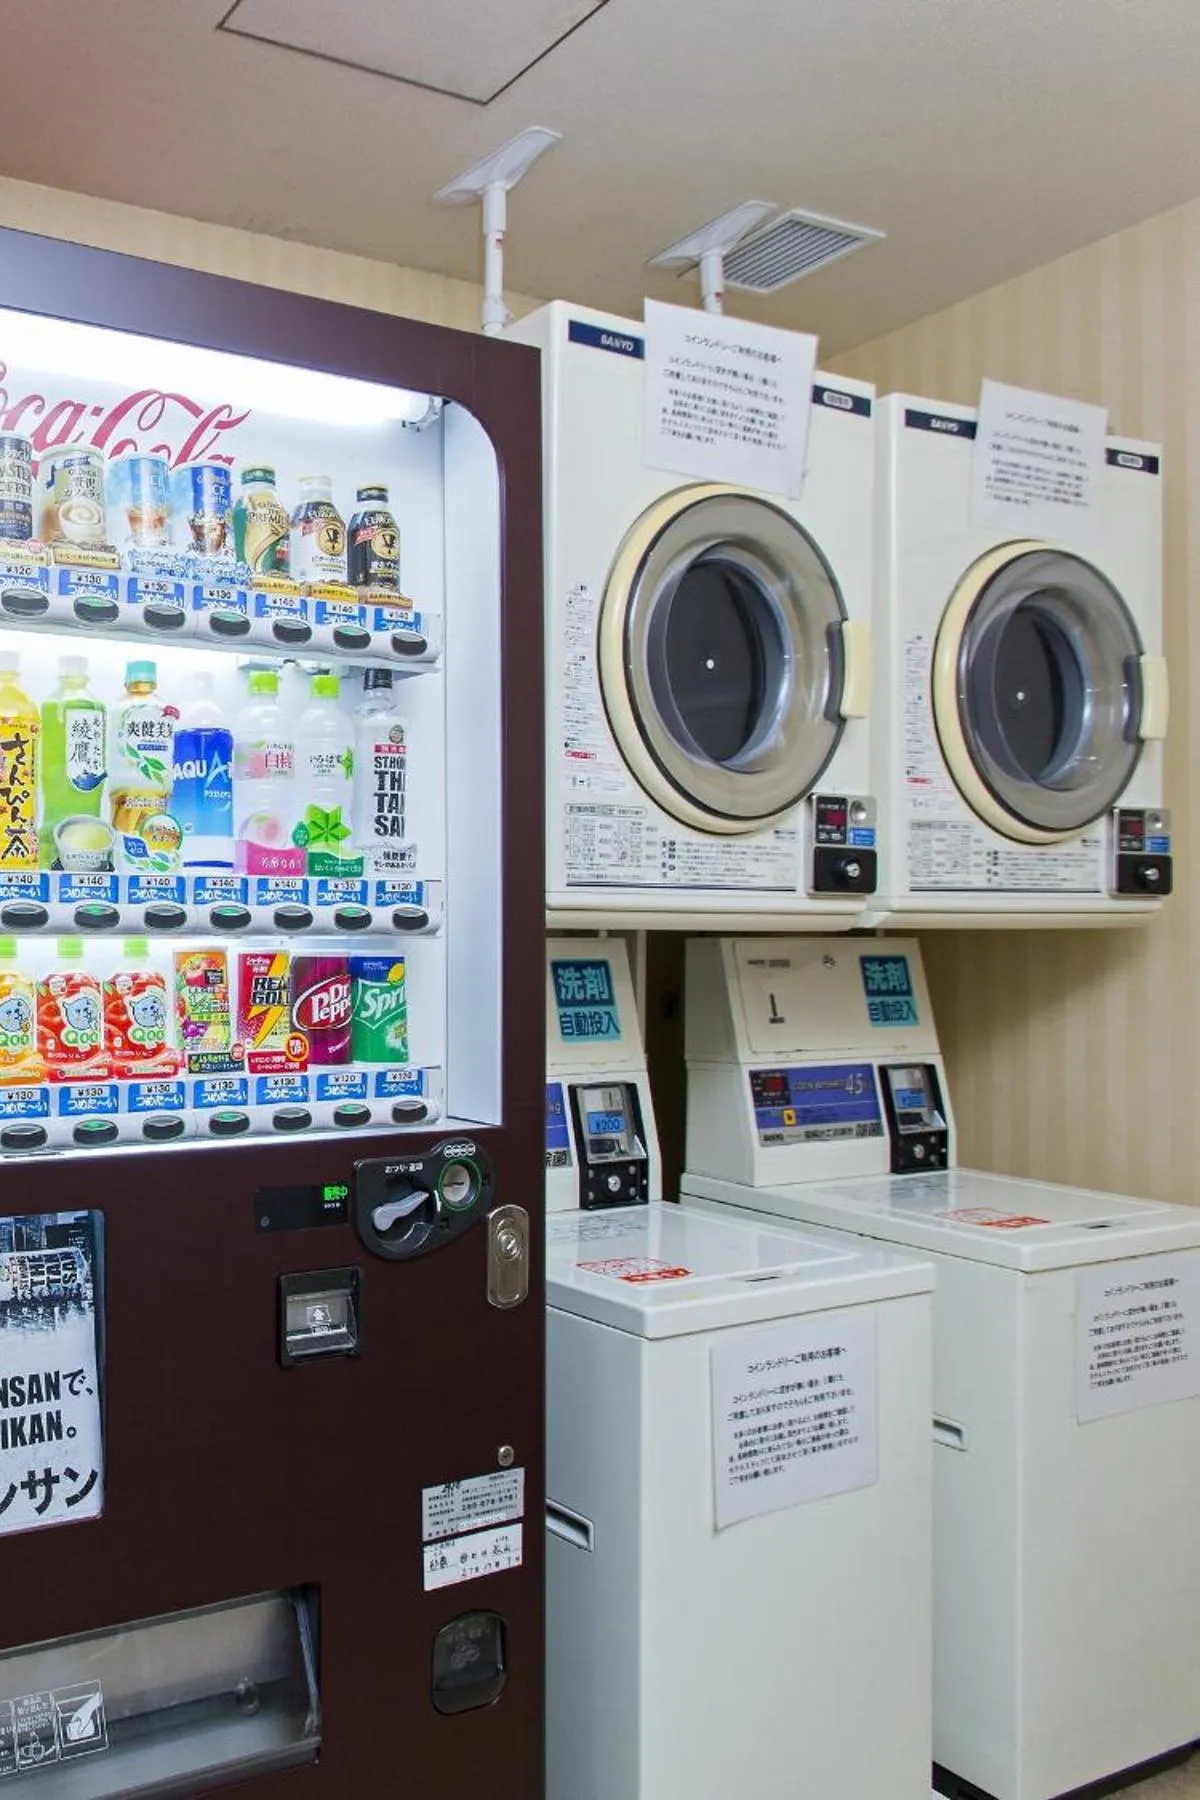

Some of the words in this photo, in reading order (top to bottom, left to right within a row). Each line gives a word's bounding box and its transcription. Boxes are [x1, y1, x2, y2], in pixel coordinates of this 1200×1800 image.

[600, 333, 635, 351] SANYO
[209, 589, 232, 599] ¥130
[71, 717, 93, 764] 綾鷹
[373, 756, 406, 769] STRO
[0, 732, 31, 860] さんぴん茶
[373, 792, 406, 814] TA
[373, 815, 406, 840] SA
[6, 875, 33, 885] ¥140
[78, 876, 103, 886] ¥140
[146, 877, 171, 887] ¥140
[211, 879, 235, 888] ¥140
[274, 880, 297, 889] ¥140
[557, 966, 609, 1000] 洗剤
[863, 961, 908, 992] 洗剤
[560, 1010, 621, 1036] 自動投入
[64, 1029, 98, 1045] Qoo
[131, 1027, 165, 1042] Qoo
[77, 1087, 103, 1097] ¥130
[146, 1084, 171, 1093] ¥130
[7, 1091, 34, 1100] ¥130
[595, 1118, 620, 1131] ¥200
